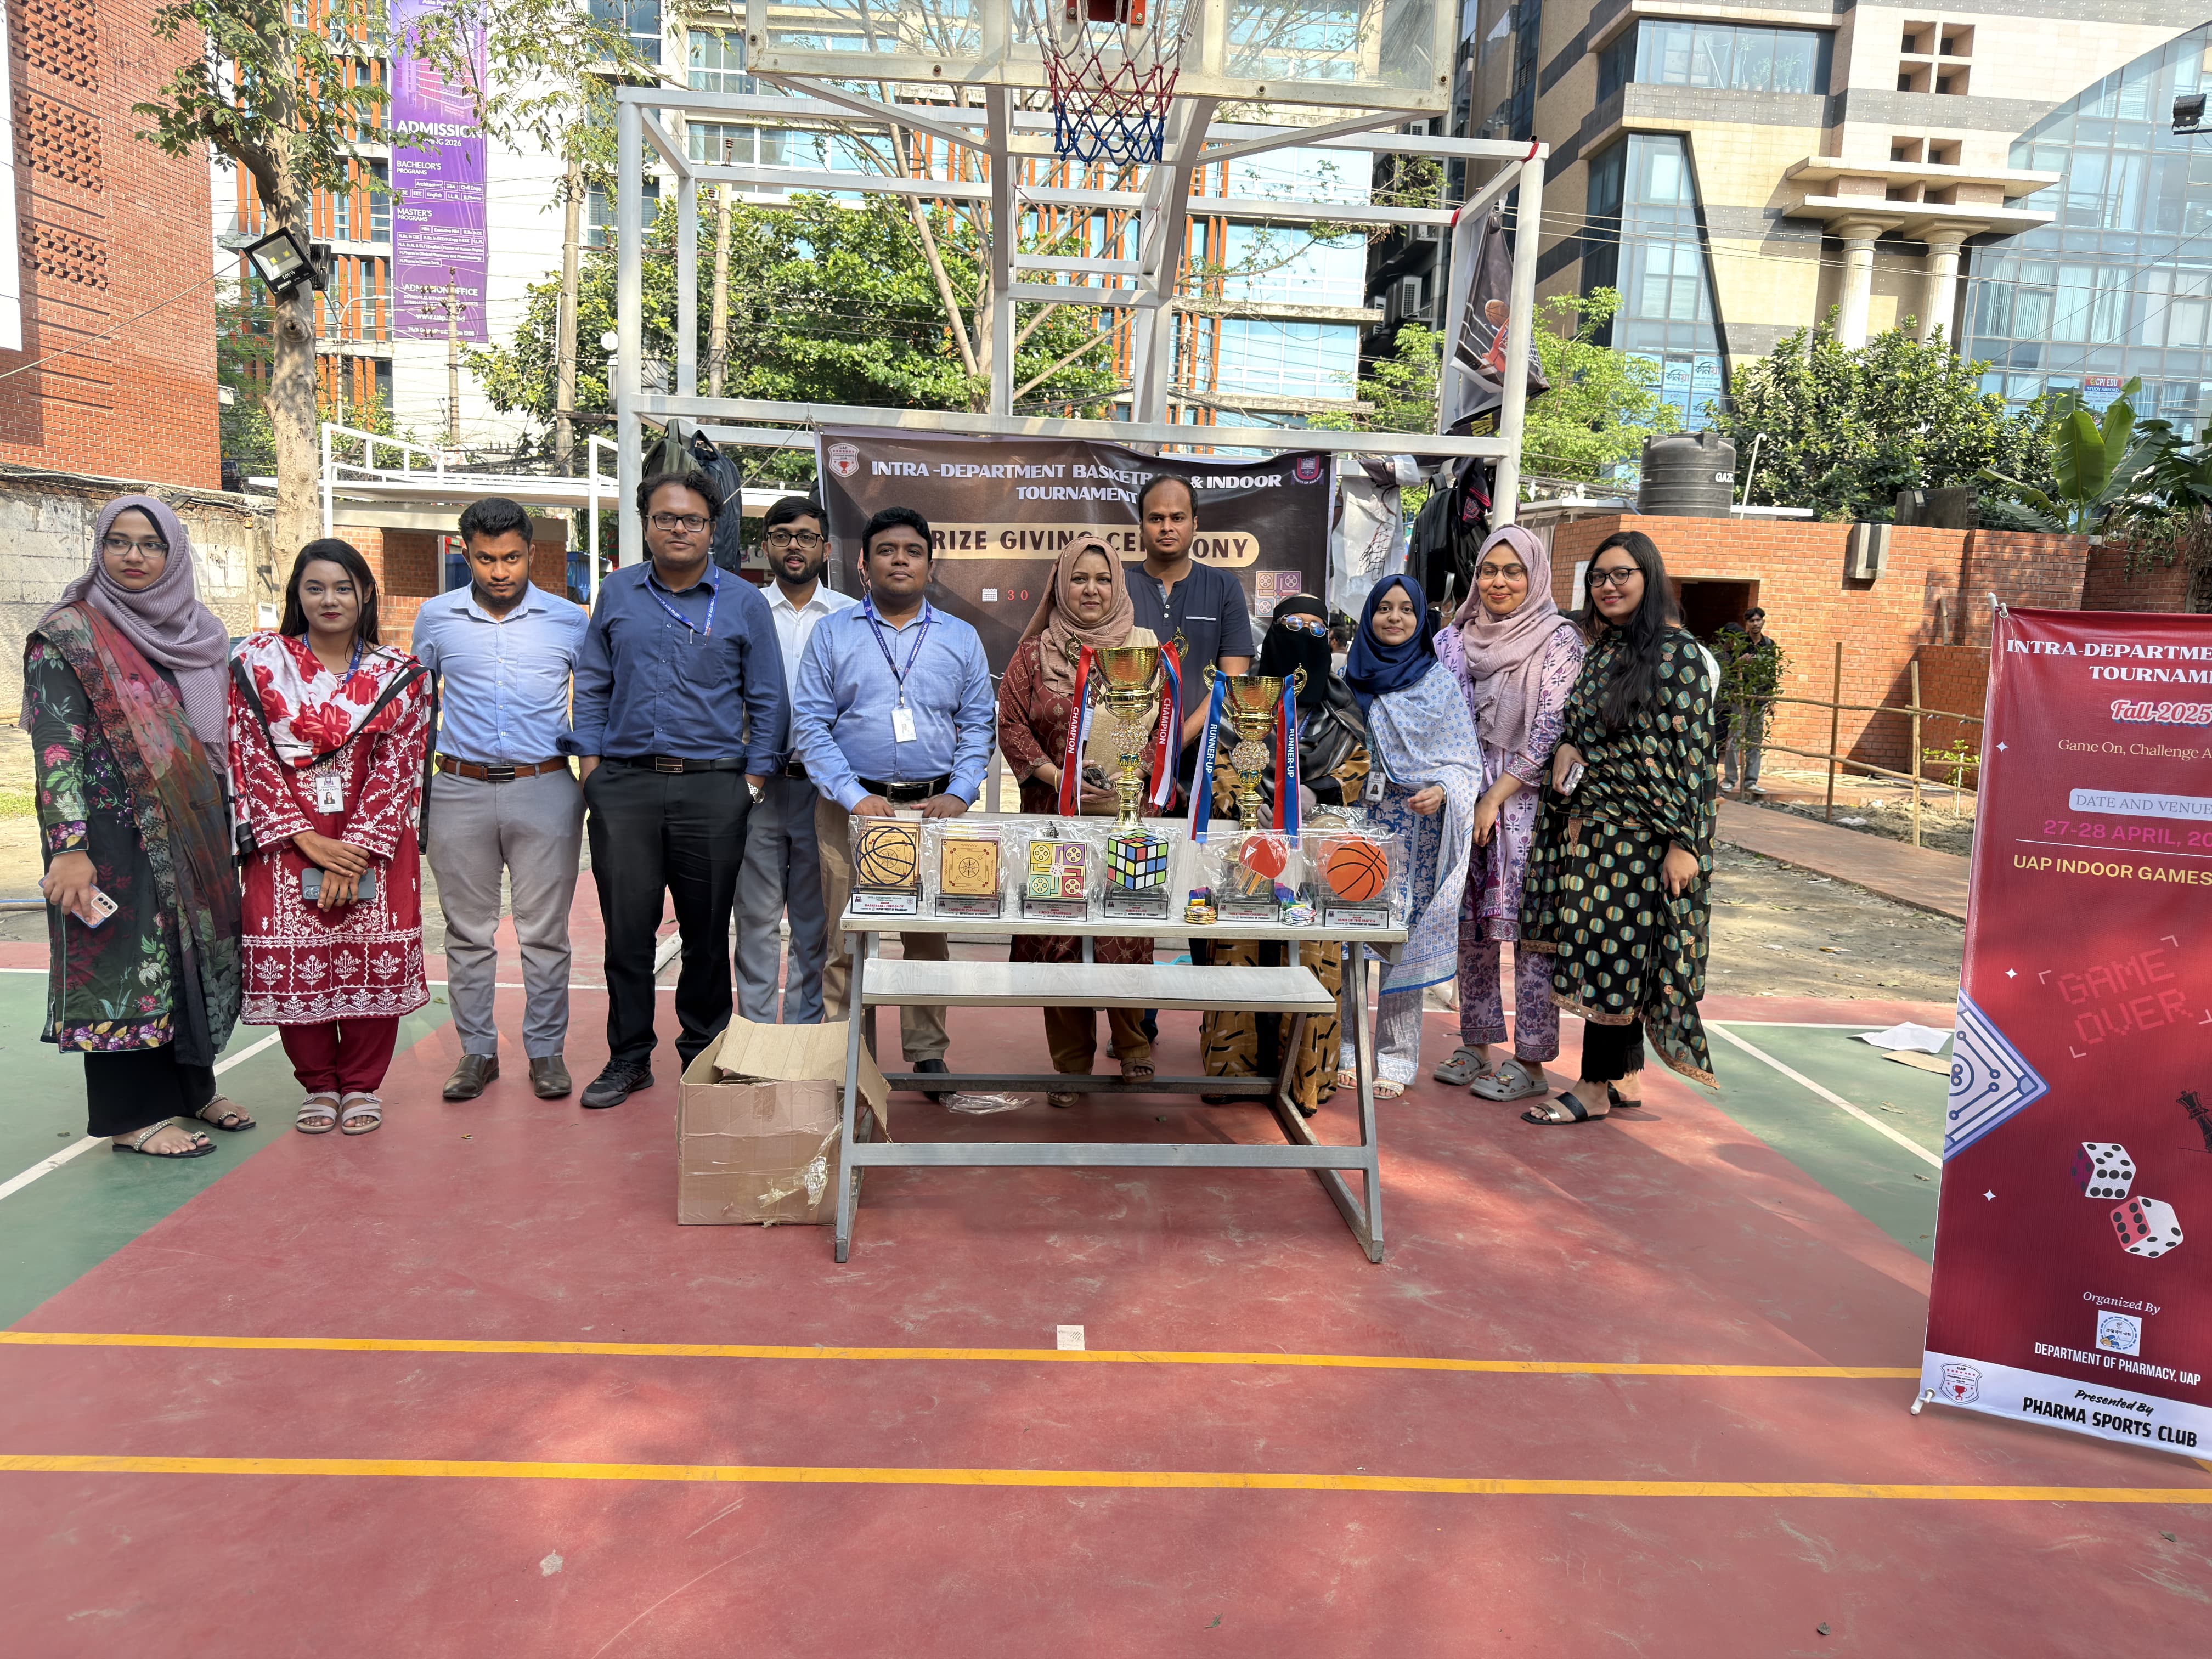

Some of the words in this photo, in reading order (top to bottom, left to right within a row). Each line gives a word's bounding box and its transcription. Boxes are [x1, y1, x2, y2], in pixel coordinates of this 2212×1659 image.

[444, 138, 462, 146] 2026
[397, 160, 442, 170] BACHELOR'S
[397, 208, 432, 217] MASTER'S
[281, 269, 296, 280] 100W
[2096, 377, 2106, 386] CPI
[872, 461, 929, 477] INTRA
[1190, 475, 1203, 488] &
[1207, 474, 1282, 488] INDOOR
[1016, 487, 1137, 504] TOURNAMENT
[931, 530, 988, 551] RIZE
[1000, 531, 1092, 550] GIVIN
[1107, 532, 1248, 559] CEONY
[670, 609, 683, 619] PACIFIC
[869, 616, 879, 634] UNIVERSITY
[910, 644, 918, 662] UNIVERSITY
[1159, 698, 1171, 745] CHAMPION
[2111, 699, 2212, 728] Fall-2025
[1068, 706, 1079, 754] CHAMPION
[1205, 723, 1218, 774] RUNNER-UP
[1286, 728, 1295, 778] RUNNER-UP
[2058, 739, 2098, 753] Game
[2102, 741, 2126, 754] On,
[2130, 743, 2198, 761] Challenge
[2076, 794, 2115, 809] DATE
[2119, 797, 2153, 811] AND
[2159, 800, 2212, 815] VENUE
[2044, 820, 2106, 839] 27-28
[2111, 825, 2182, 848] APRIL,
[2014, 855, 2052, 871] UAP
[2056, 859, 2133, 879] INDOOR
[2138, 866, 2212, 885] GAMES
[2057, 947, 2176, 1005] GAME
[2074, 988, 2193, 1045] OVER
[2083, 1291, 2143, 1311] Organized
[2145, 1302, 2161, 1316] By
[2034, 1342, 2101, 1368] DEPARTMENT
[2103, 1356, 2117, 1369] OF
[2119, 1359, 2177, 1384] PHARMACY,
[2179, 1371, 2201, 1386] UAP
[2074, 1389, 2135, 1412] Presented
[2135, 1402, 2154, 1417] By
[2022, 1397, 2086, 1424] PHARMA
[2092, 1411, 2152, 1438] SPORTS
[2158, 1425, 2198, 1448] CLUB
